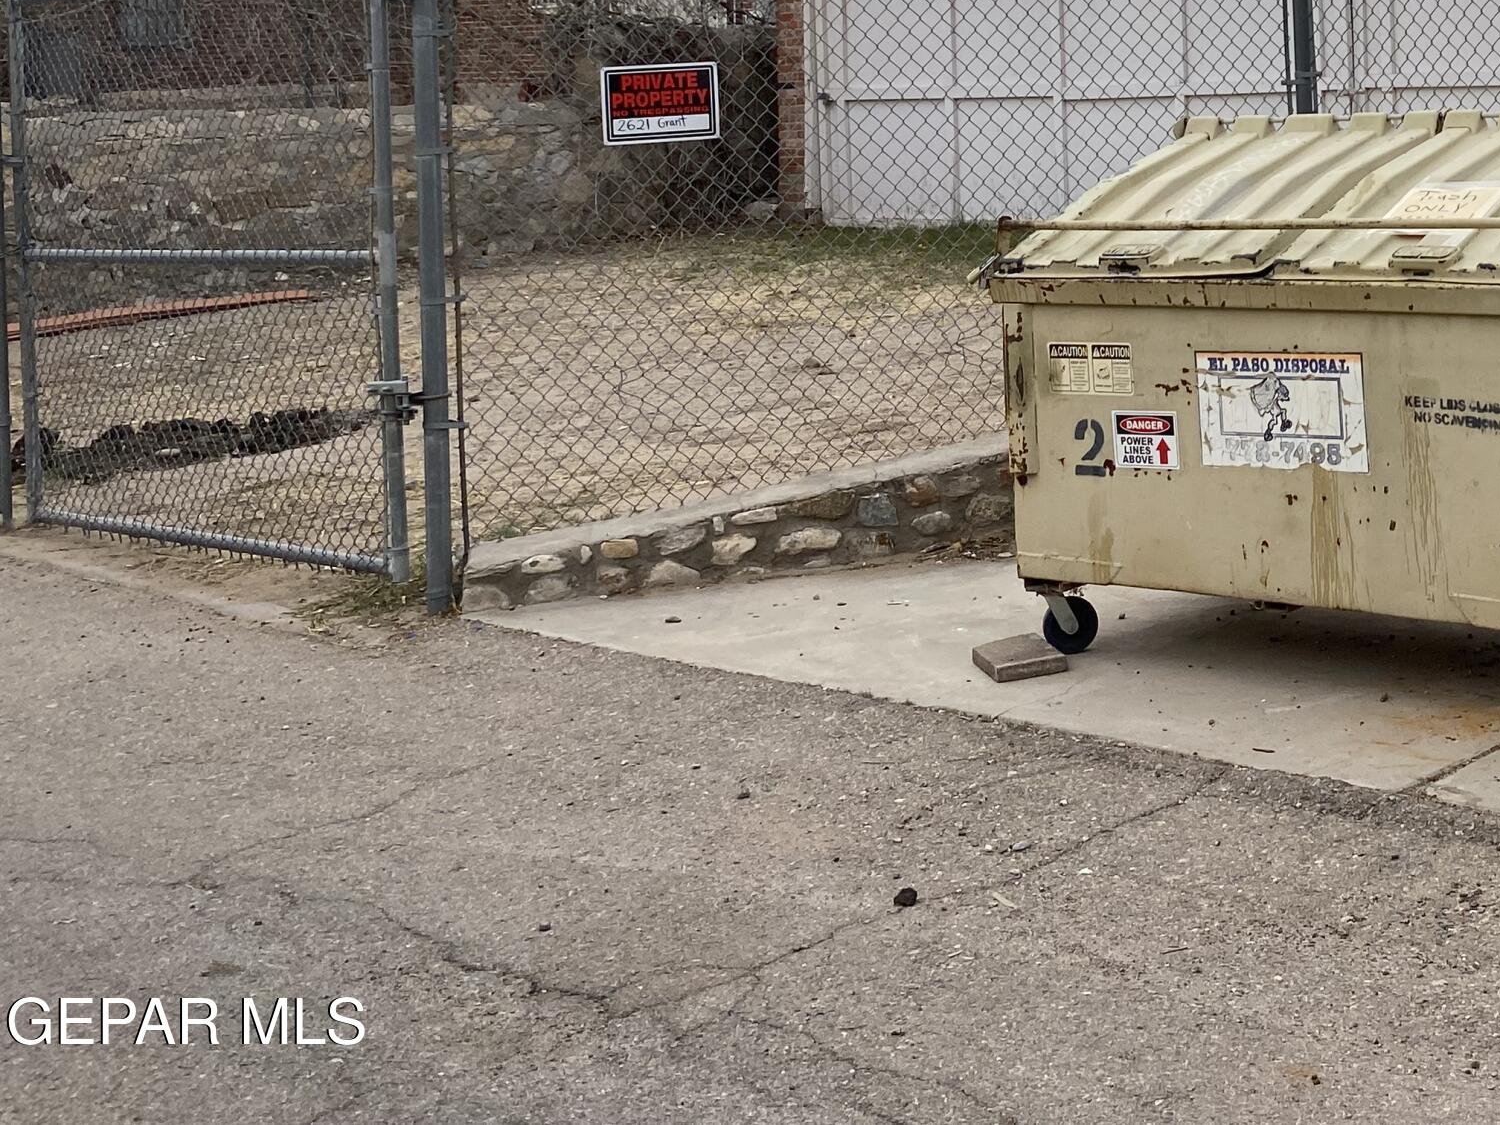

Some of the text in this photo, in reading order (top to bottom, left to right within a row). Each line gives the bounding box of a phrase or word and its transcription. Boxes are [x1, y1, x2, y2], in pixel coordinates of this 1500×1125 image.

[621, 71, 699, 91] PRIVATE
[611, 88, 708, 108] PROPERTY
[612, 105, 710, 118] NO TRESPASSING
[617, 115, 688, 132] 2621 Grant
[1418, 190, 1477, 201] Trash
[1404, 202, 1468, 213] ONLY
[1099, 347, 1130, 358] CAUTION
[1207, 357, 1350, 374] EL PASO DISPOSAL
[1404, 395, 1436, 408] KEEP
[1413, 411, 1432, 424] NO
[1126, 419, 1164, 430] DANGER
[1121, 436, 1154, 446] POWER
[1074, 419, 1106, 477] 2
[1124, 446, 1151, 455] LINES
[1122, 455, 1154, 464] ABOVE
